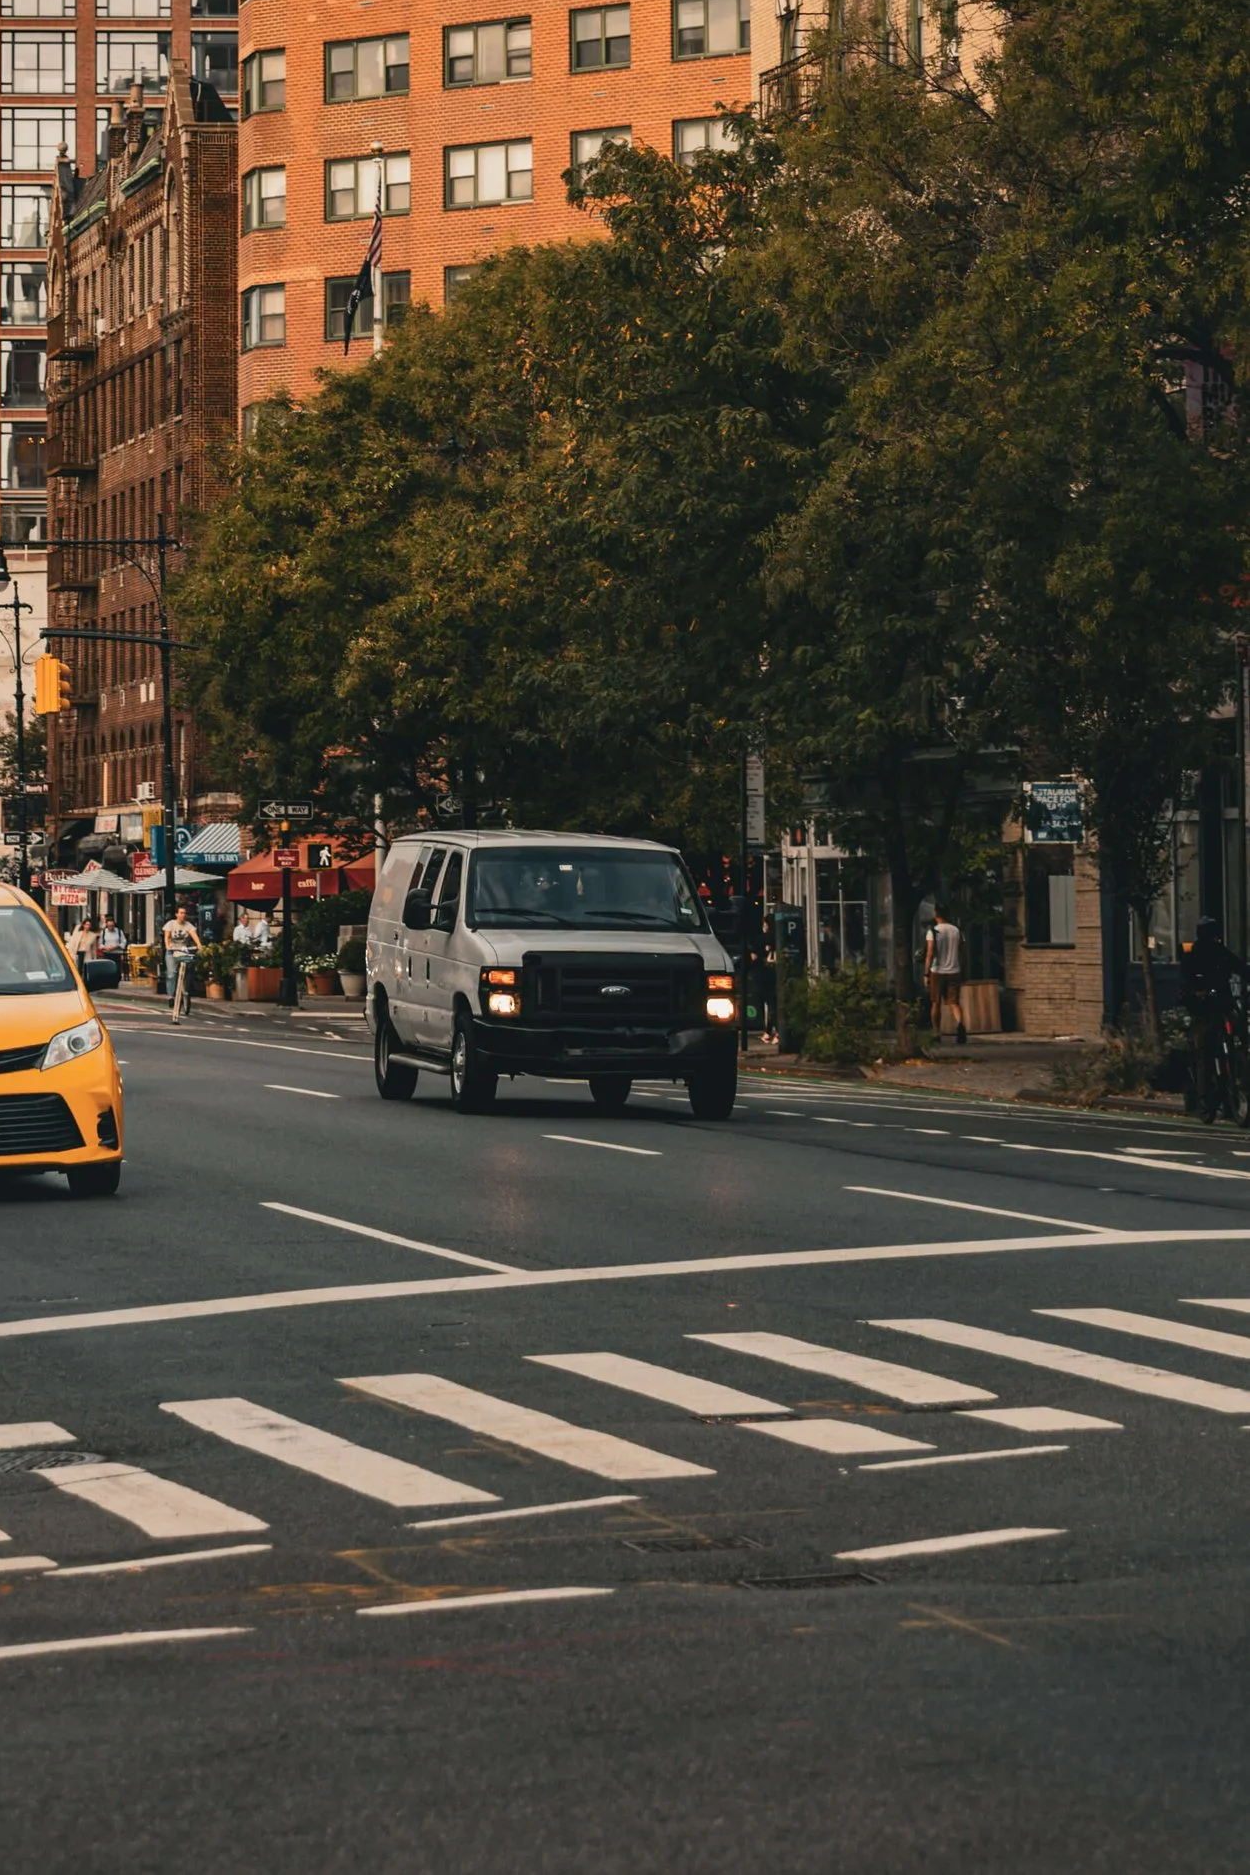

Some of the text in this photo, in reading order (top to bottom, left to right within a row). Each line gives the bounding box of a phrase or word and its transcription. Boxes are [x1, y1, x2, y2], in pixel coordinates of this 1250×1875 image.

[267, 806, 306, 814] ONE WAY
[204, 853, 217, 862] THE
[218, 853, 239, 862] PERRY
[251, 882, 265, 891] bar
[60, 894, 79, 904] PIZZA
